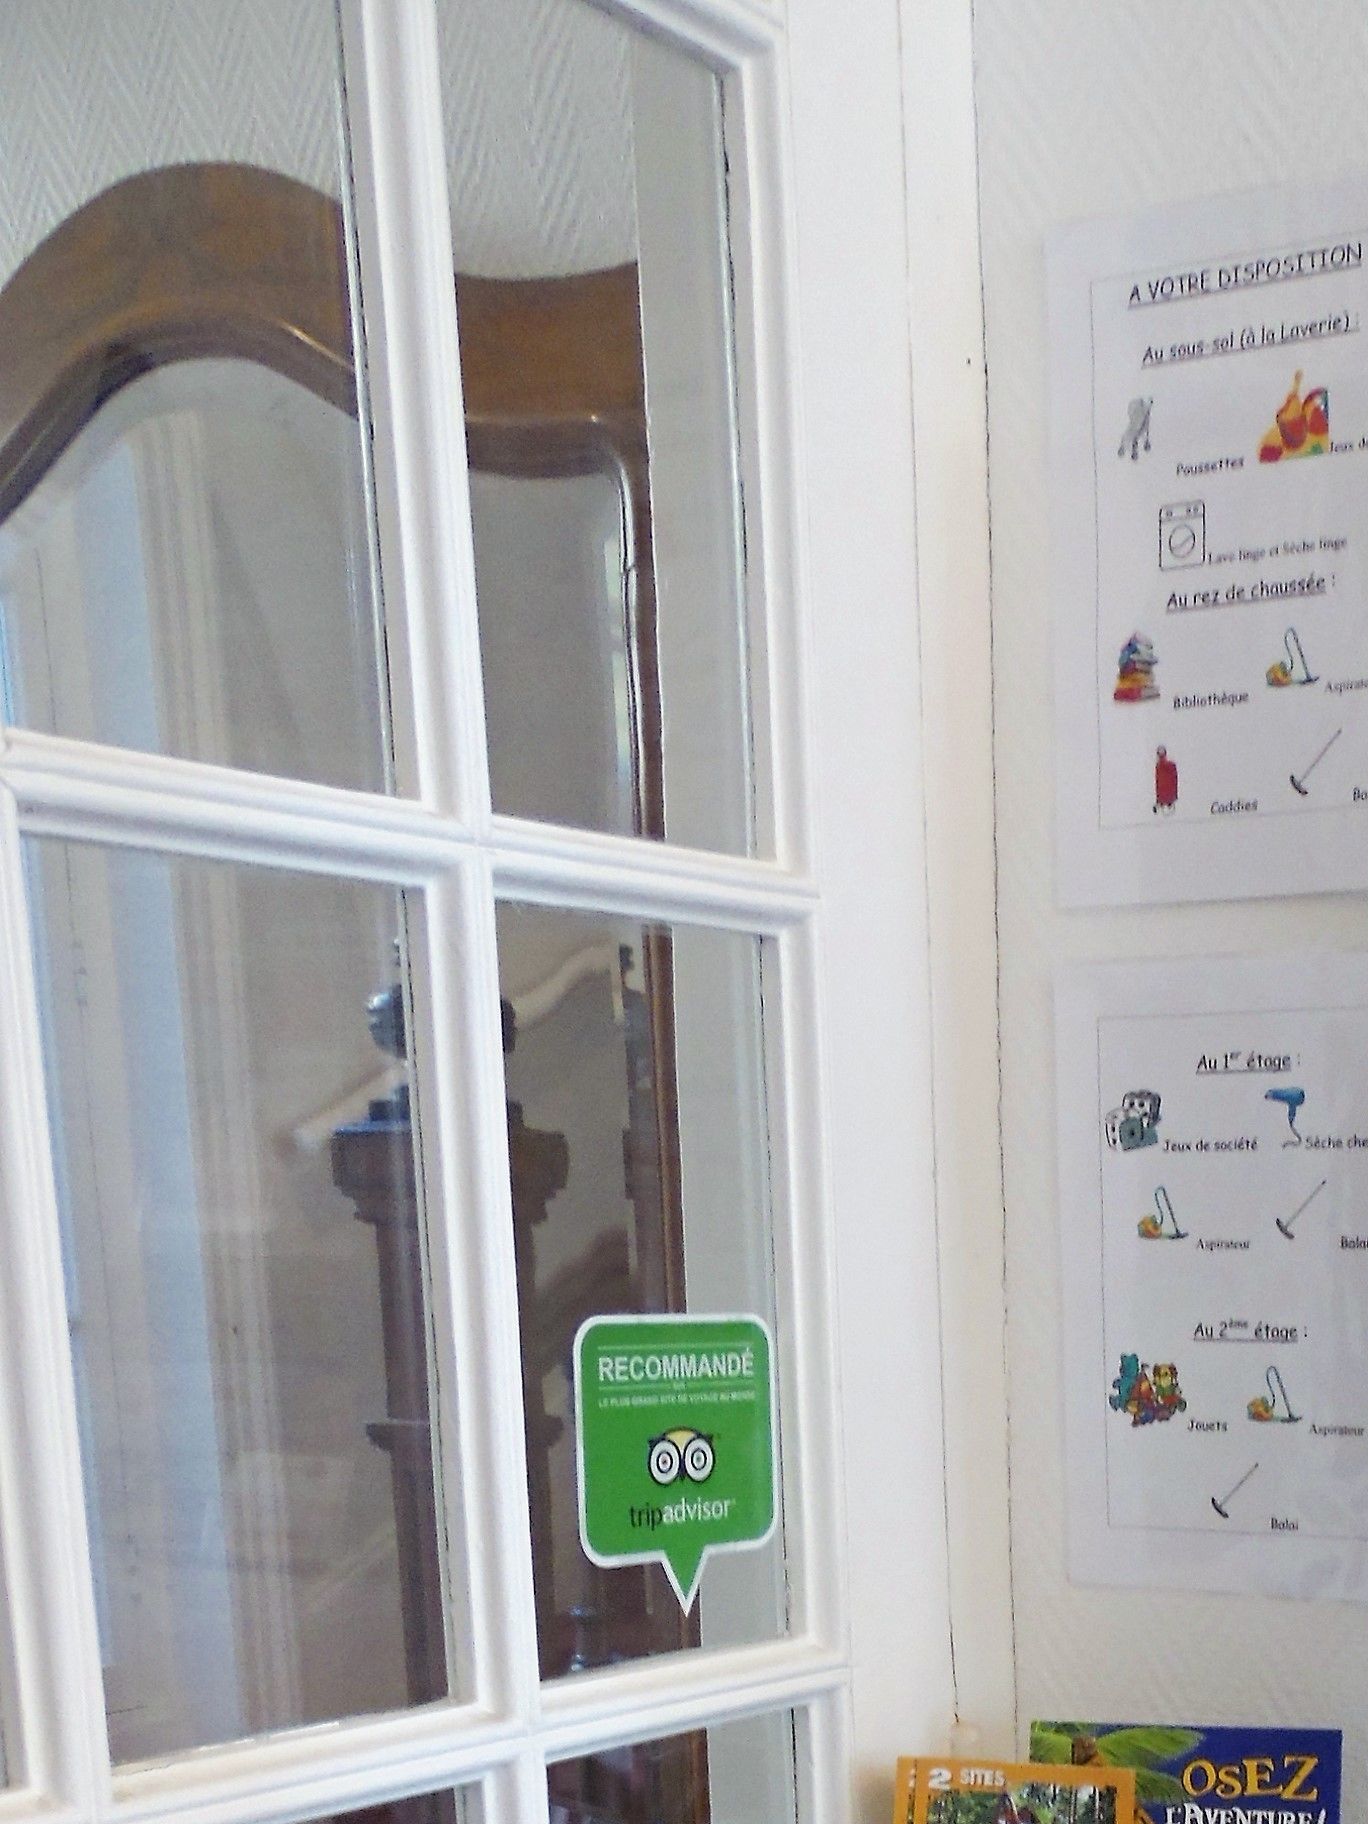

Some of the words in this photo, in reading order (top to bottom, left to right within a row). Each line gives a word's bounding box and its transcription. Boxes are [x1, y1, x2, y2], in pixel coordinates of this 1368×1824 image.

[1127, 284, 1142, 305] A
[1148, 269, 1211, 301] VOTRE
[1218, 242, 1362, 292] DISPOSITION
[1142, 345, 1164, 366] Au
[1259, 322, 1276, 344] la
[1175, 455, 1246, 479] Poussettes
[1166, 590, 1189, 611] Au
[1193, 588, 1221, 607] rez
[1225, 583, 1246, 603] de
[1250, 571, 1328, 599] chaussée
[1172, 689, 1251, 712] Bibliothèque
[1196, 1053, 1219, 1071] Au
[1246, 1052, 1293, 1073] étage
[1162, 1137, 1193, 1154] Jeux
[1195, 1136, 1212, 1153] de
[1213, 1136, 1260, 1152] société
[1193, 1321, 1215, 1340] Au
[1254, 1321, 1299, 1342] étage
[597, 1346, 755, 1383] RECOMMANDÉ
[1187, 1417, 1229, 1433] Jouets
[630, 1496, 731, 1532] tripadvisor
[927, 1768, 953, 1791] 2
[959, 1766, 1007, 1788] SITES
